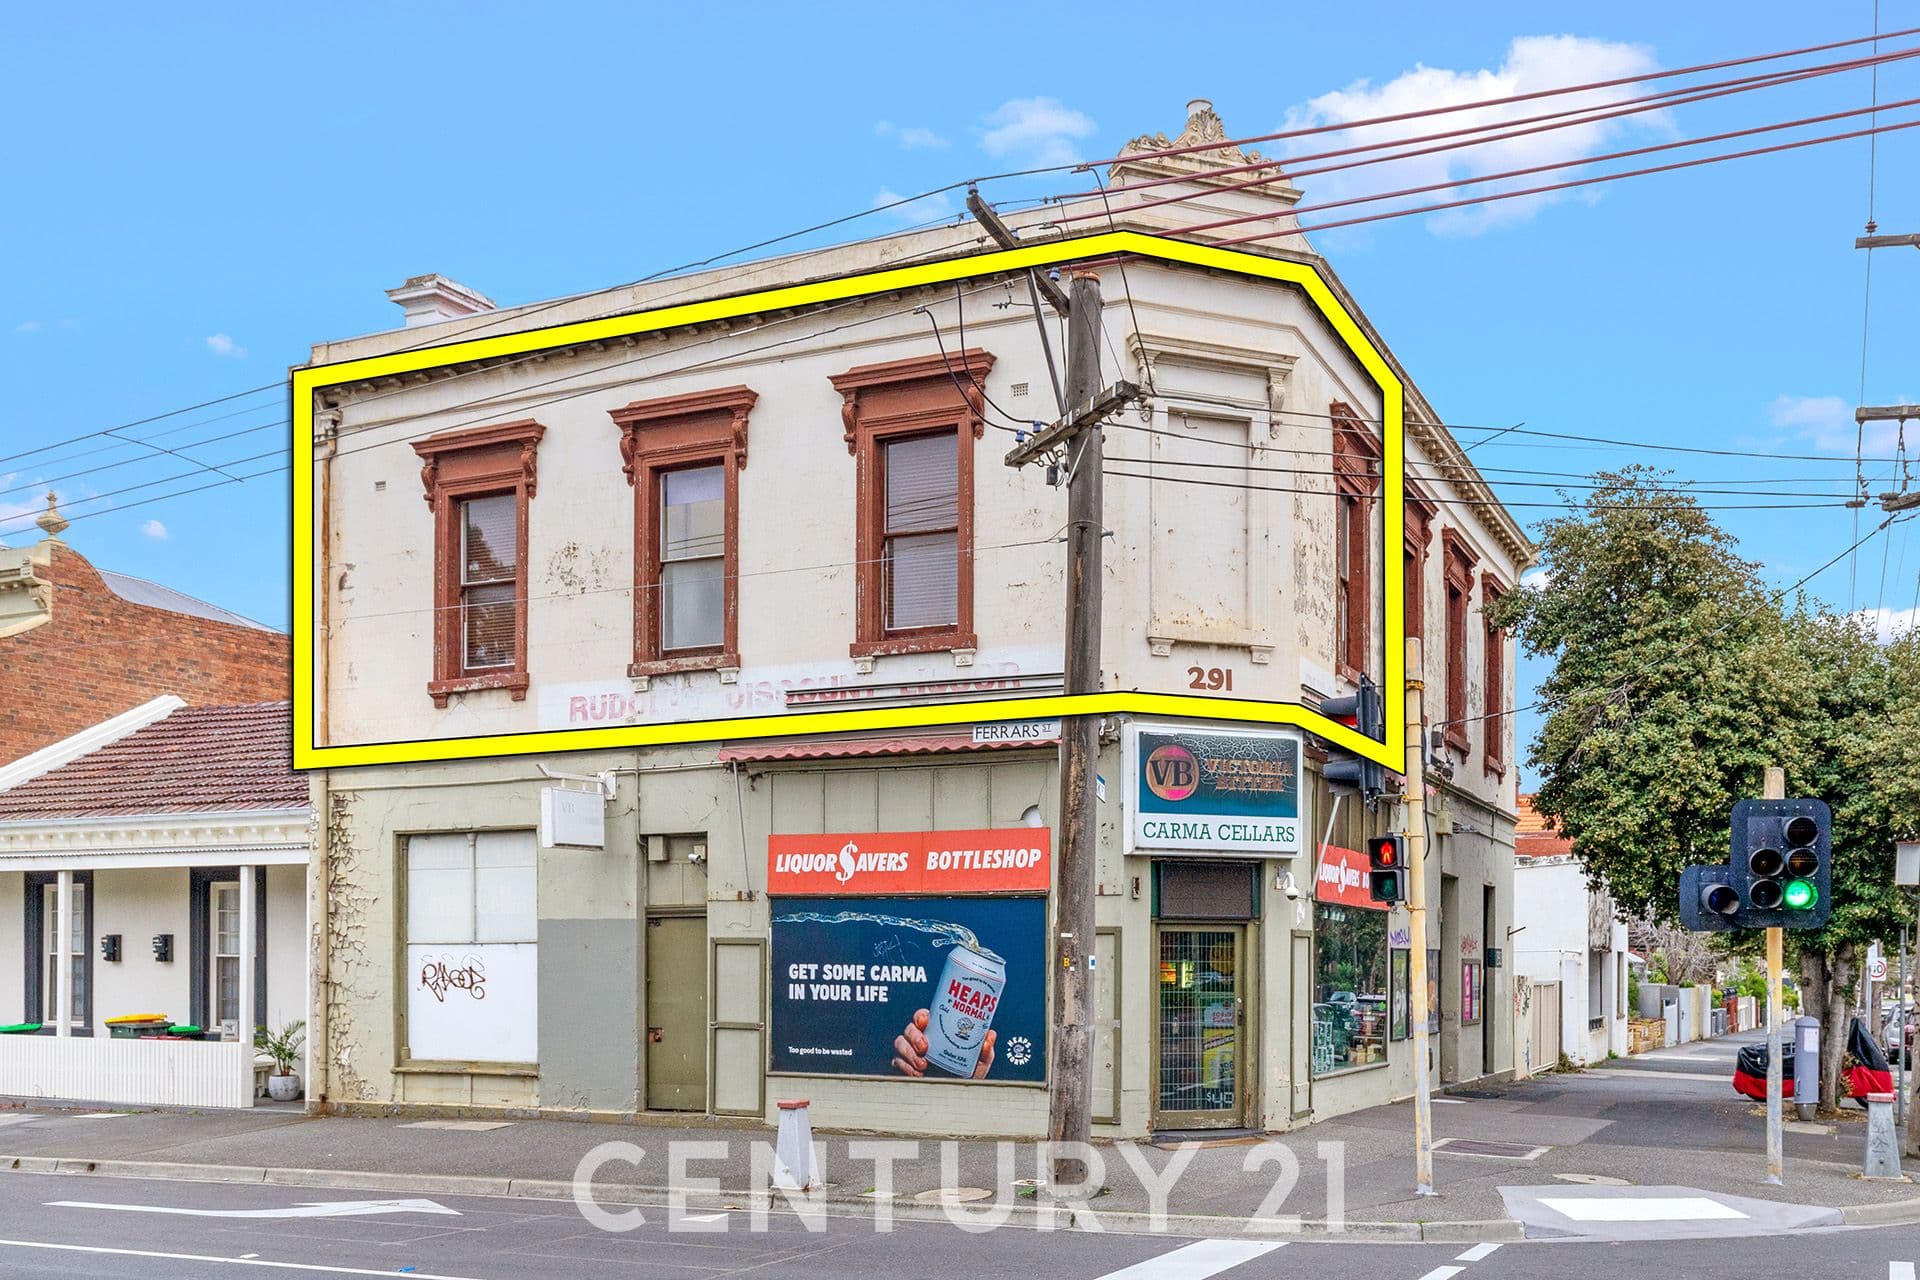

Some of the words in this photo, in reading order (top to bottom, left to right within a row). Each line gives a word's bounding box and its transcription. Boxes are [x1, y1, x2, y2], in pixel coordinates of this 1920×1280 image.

[1187, 666, 1233, 691] 291
[975, 724, 1040, 739] FERRARS
[1042, 723, 1052, 732] ST
[1150, 760, 1194, 786] VB
[1143, 822, 1212, 840] CARMA
[1218, 824, 1295, 843] CELLARS
[926, 849, 1042, 871] BOTTLESHOP
[788, 964, 819, 980] GET
[823, 965, 866, 982] SOME
[871, 965, 928, 983] CARMA
[788, 983, 805, 1000] IN
[810, 984, 851, 1001] YOUR
[856, 985, 889, 1002] LIFE
[948, 979, 998, 1013] HEAPS
[952, 1001, 986, 1022] NORMAL
[788, 1046, 800, 1054] Too
[800, 1047, 815, 1056] good
[1007, 1036, 1032, 1049] HEAPS
